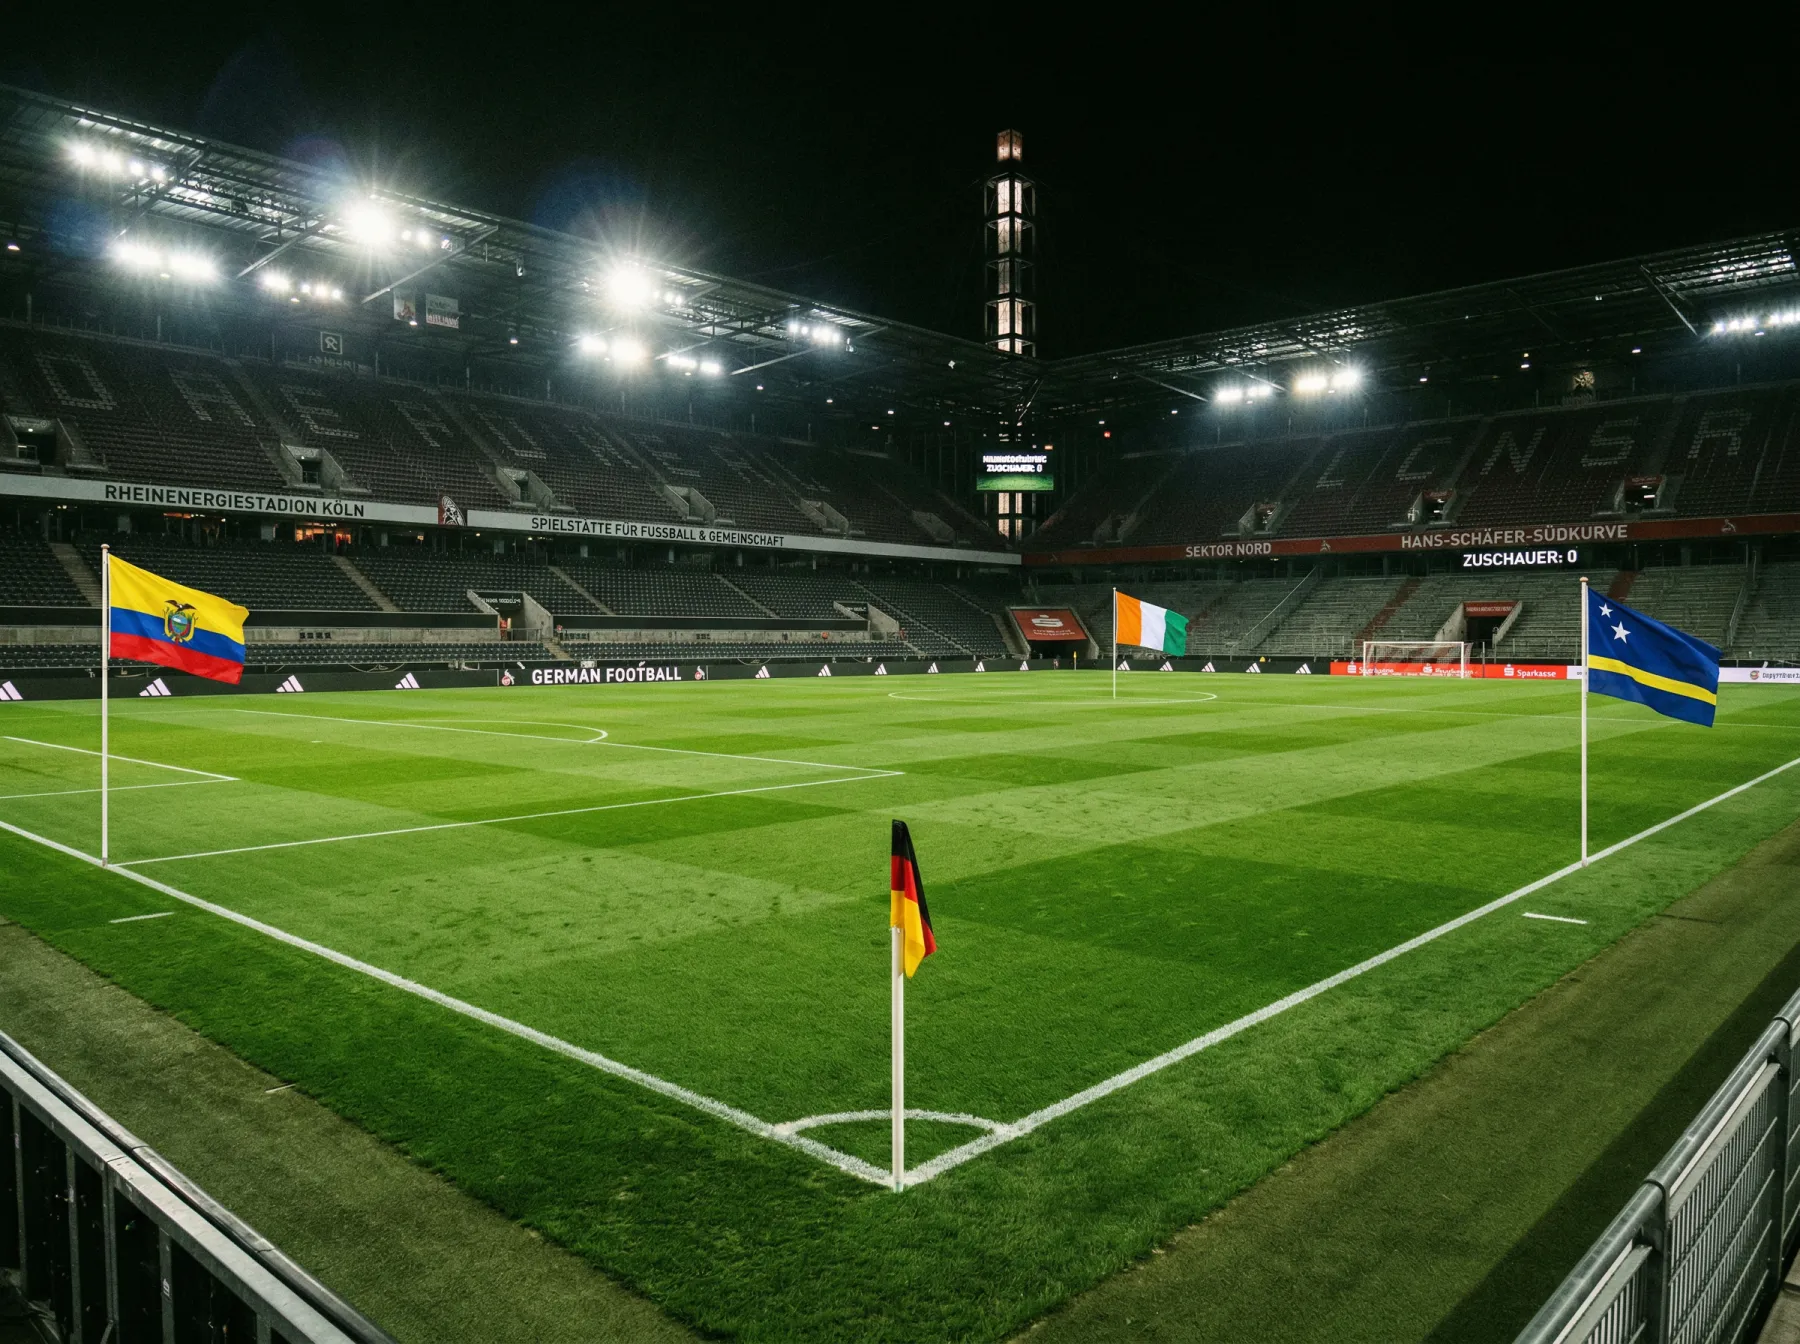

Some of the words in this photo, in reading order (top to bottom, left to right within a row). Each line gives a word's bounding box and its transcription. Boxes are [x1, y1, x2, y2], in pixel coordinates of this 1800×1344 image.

[105, 484, 317, 514] RHEINENERGIESTADION
[322, 499, 365, 517] KÖLN
[615, 521, 638, 536] FÜR
[641, 525, 696, 541] FUSSBALL
[698, 530, 706, 541] &
[708, 530, 785, 547] GEMEINSCHAFT
[1401, 524, 1628, 548] HANS-SCHÄFER-SÜDKURVE
[1185, 545, 1233, 557] SEKTOR
[1236, 542, 1272, 556] NORD
[1463, 550, 1563, 567] ZUSCHAUER:
[1567, 550, 1578, 563] 0
[531, 668, 601, 685] GERMAN
[605, 667, 682, 683] FOOTBALL
[1517, 668, 1557, 679] Sparkasse
